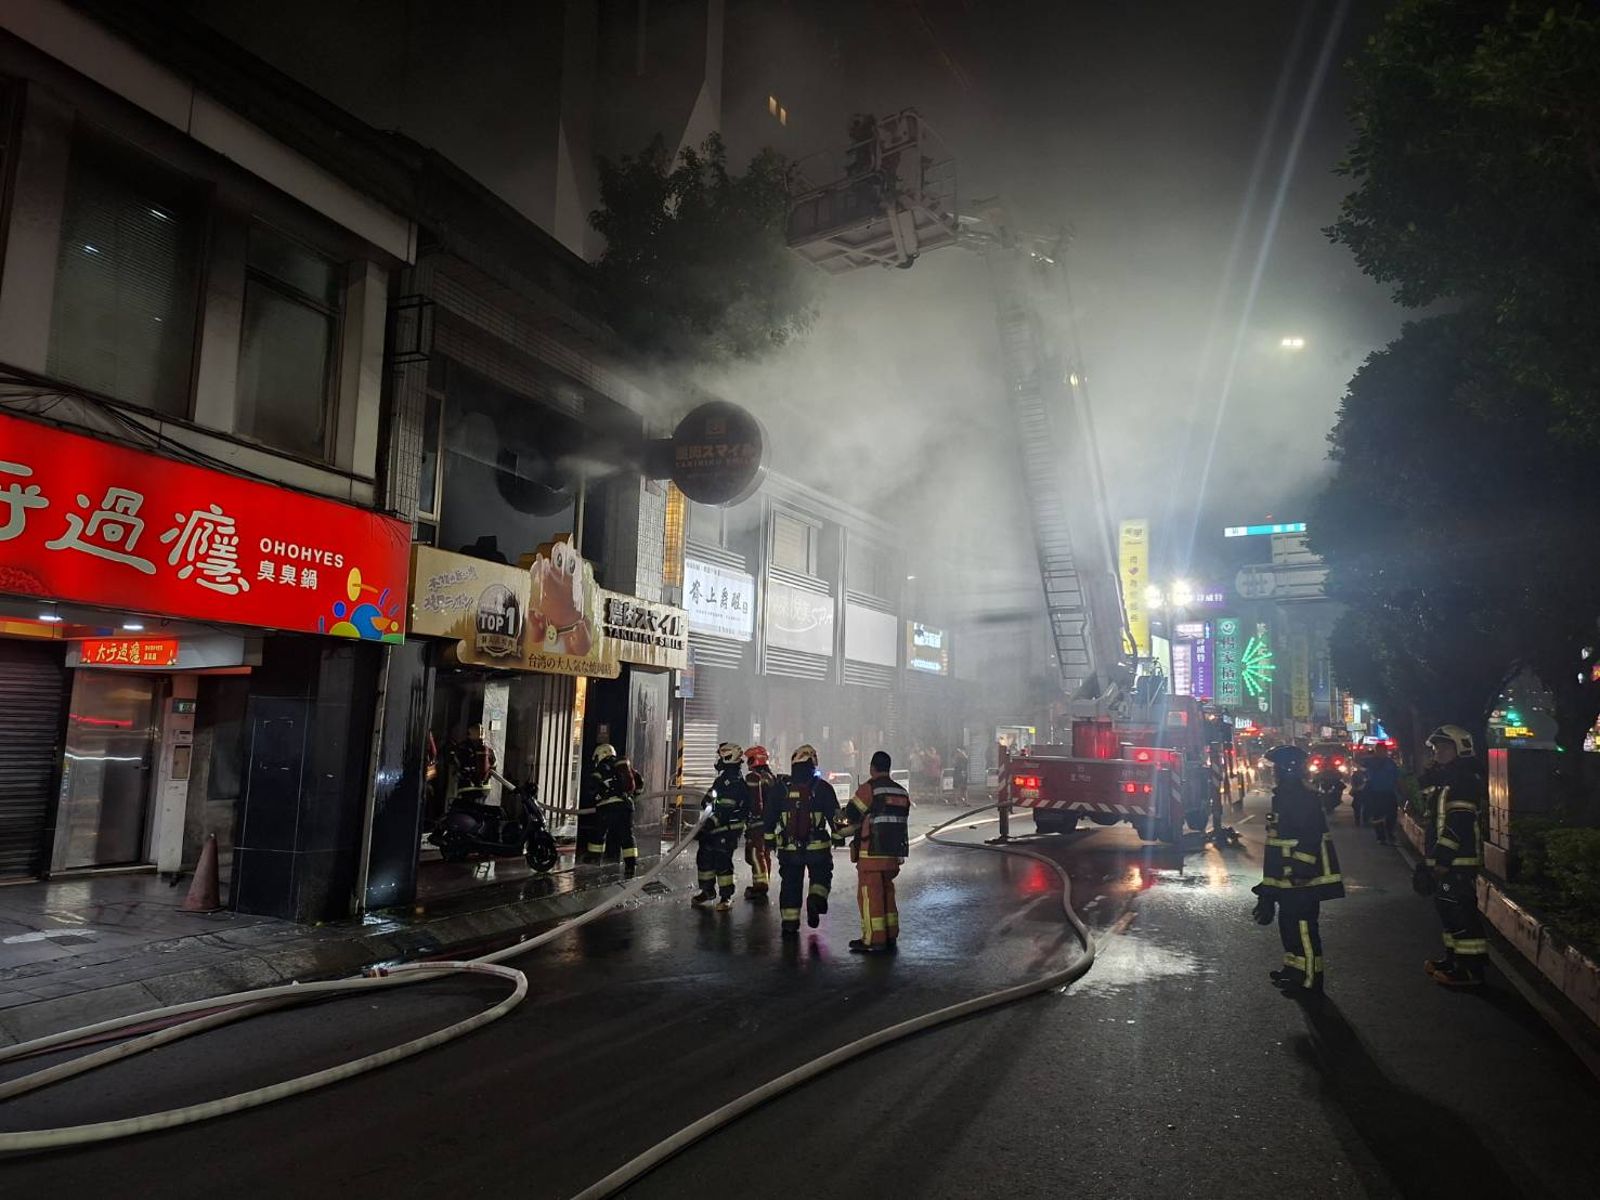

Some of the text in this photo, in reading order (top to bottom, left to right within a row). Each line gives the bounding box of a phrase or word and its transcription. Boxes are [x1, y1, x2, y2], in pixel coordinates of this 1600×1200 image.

[259, 537, 344, 568] OHOHYES
[257, 559, 318, 591] 臭臭鍋
[481, 607, 515, 635] TOP 1
